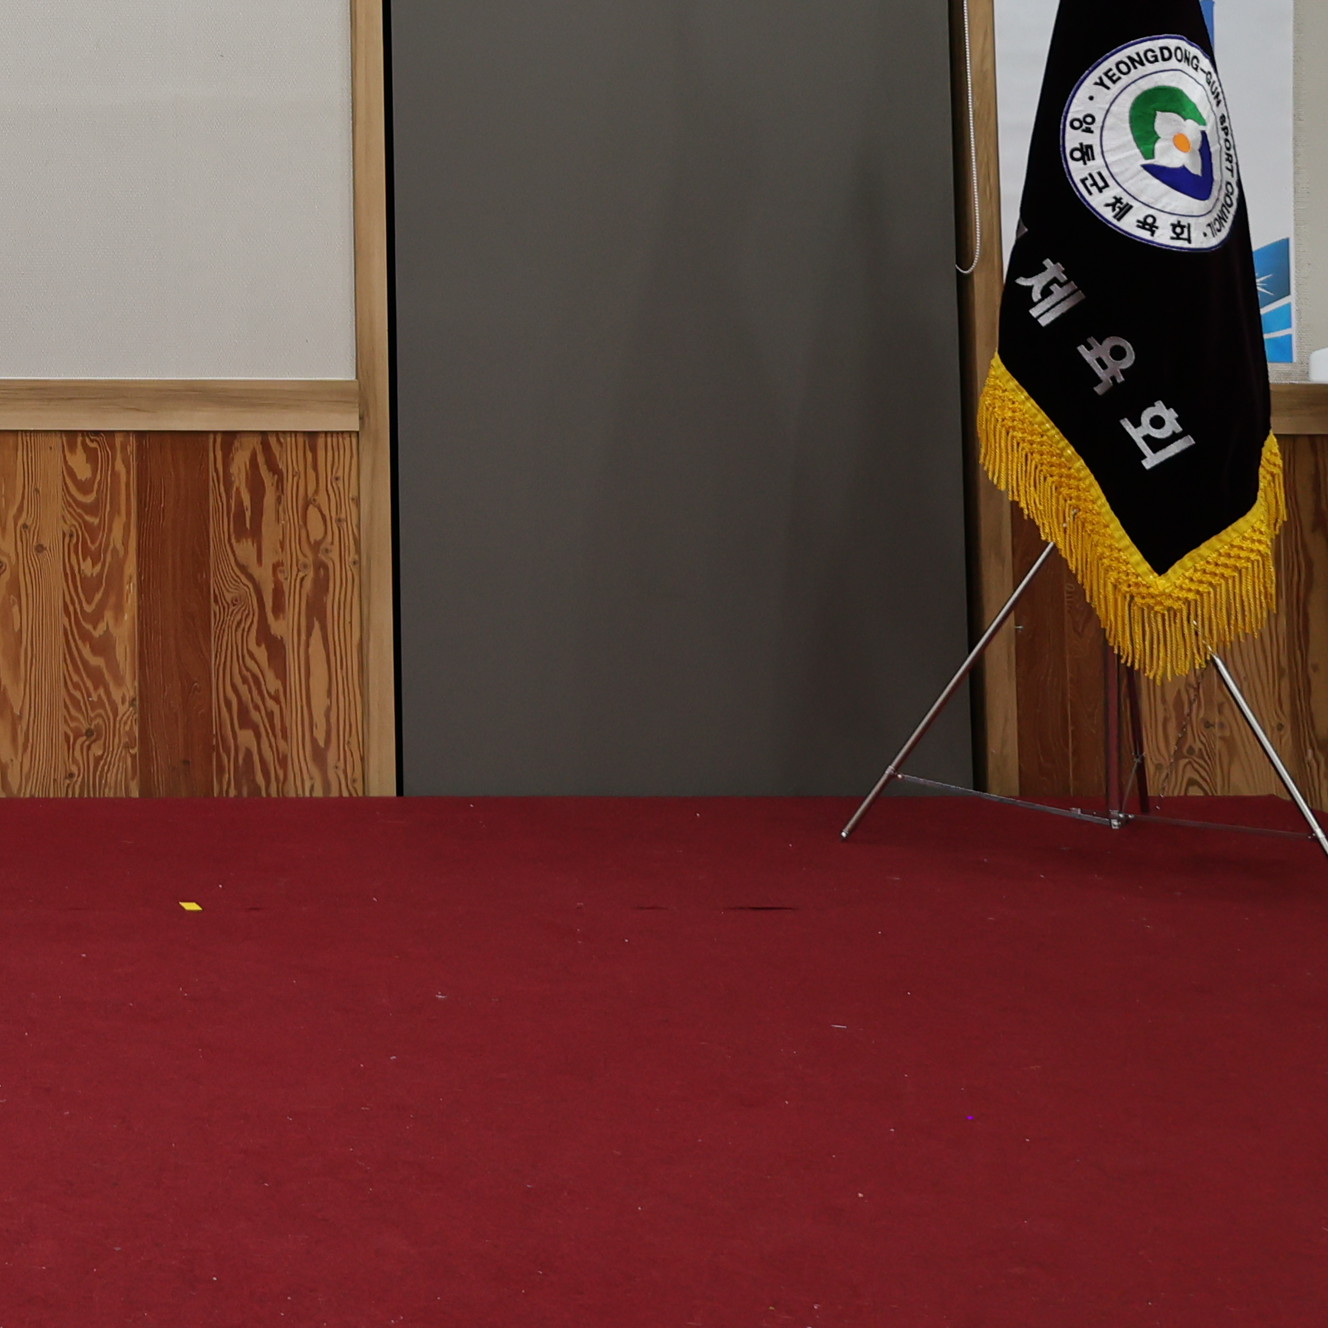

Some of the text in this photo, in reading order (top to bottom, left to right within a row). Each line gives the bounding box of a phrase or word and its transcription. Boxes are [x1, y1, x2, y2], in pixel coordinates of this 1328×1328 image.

[1093, 45, 1222, 109] YEONGDONG-GUN
[1218, 114, 1234, 177] SPORT
[1068, 112, 1192, 244] 영동군체육회
[1206, 180, 1236, 239] COUNCIL
